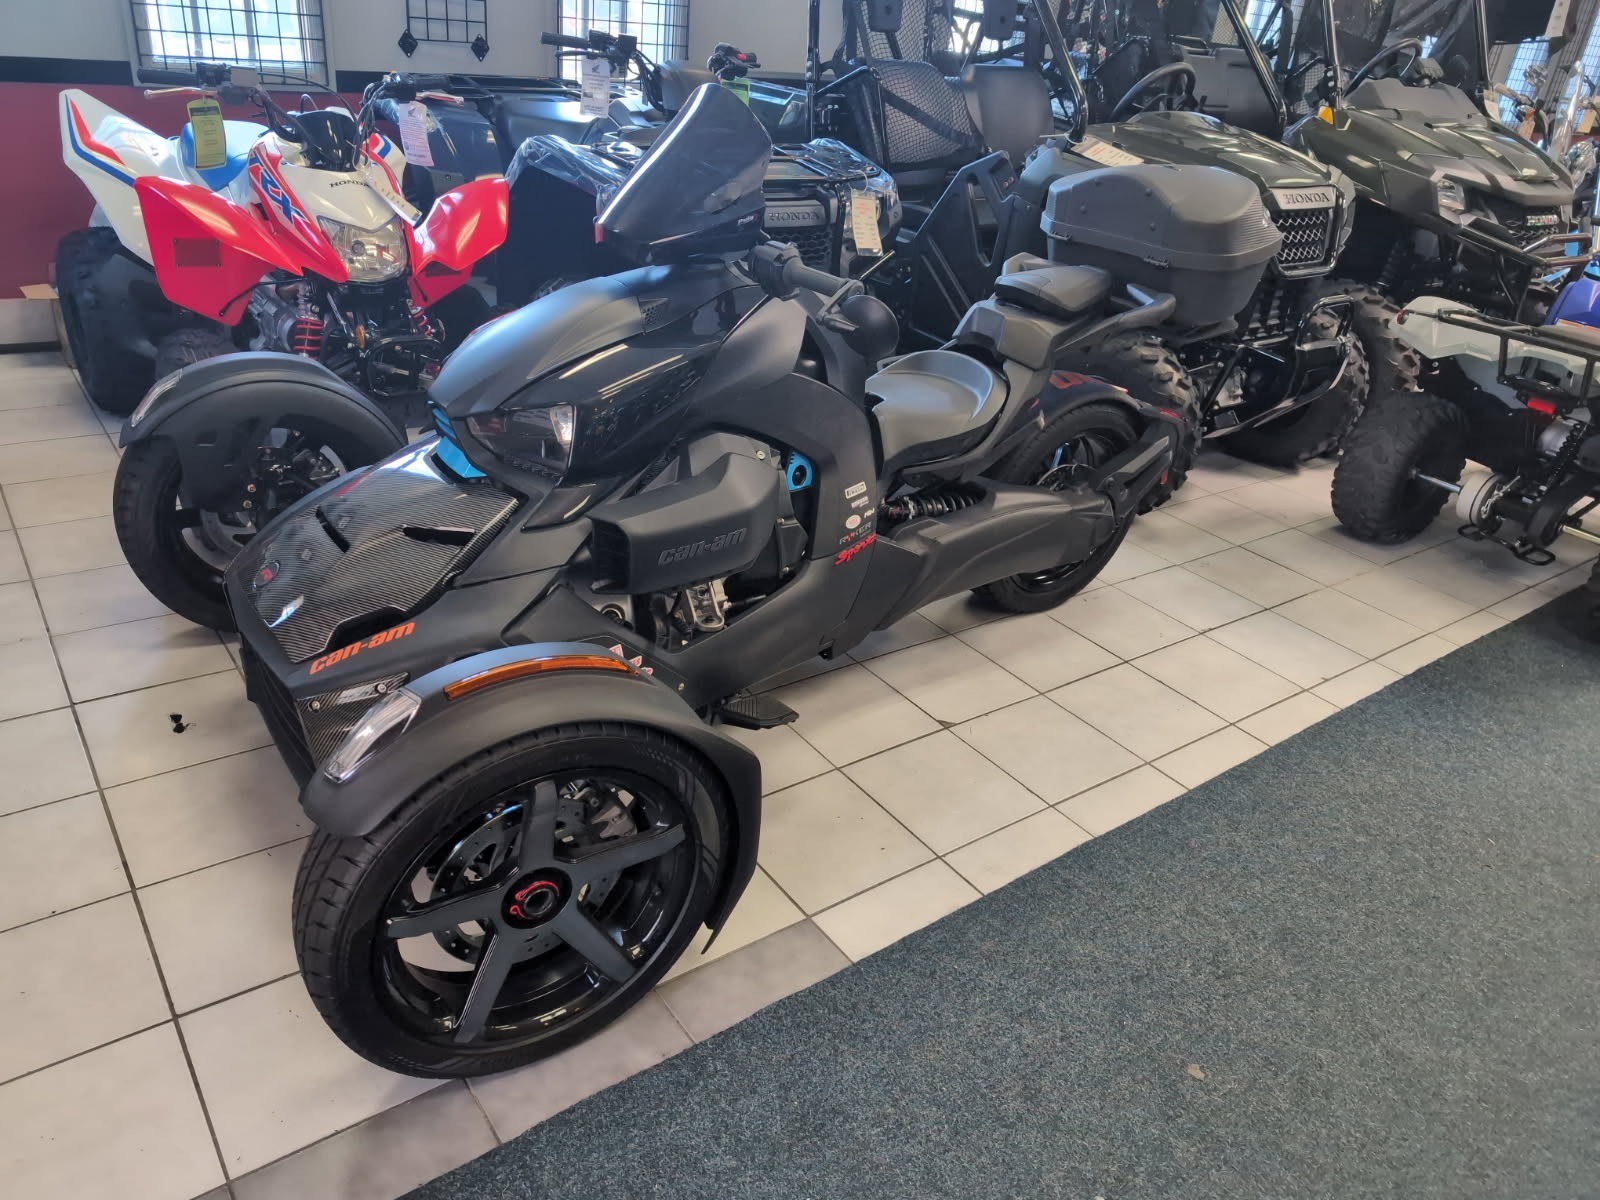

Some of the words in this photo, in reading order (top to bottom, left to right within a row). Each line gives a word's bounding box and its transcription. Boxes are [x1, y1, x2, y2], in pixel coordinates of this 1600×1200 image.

[1283, 192, 1329, 204] HONDA
[768, 211, 820, 221] HONDA
[658, 527, 747, 566] can-am
[309, 622, 416, 675] can-am
